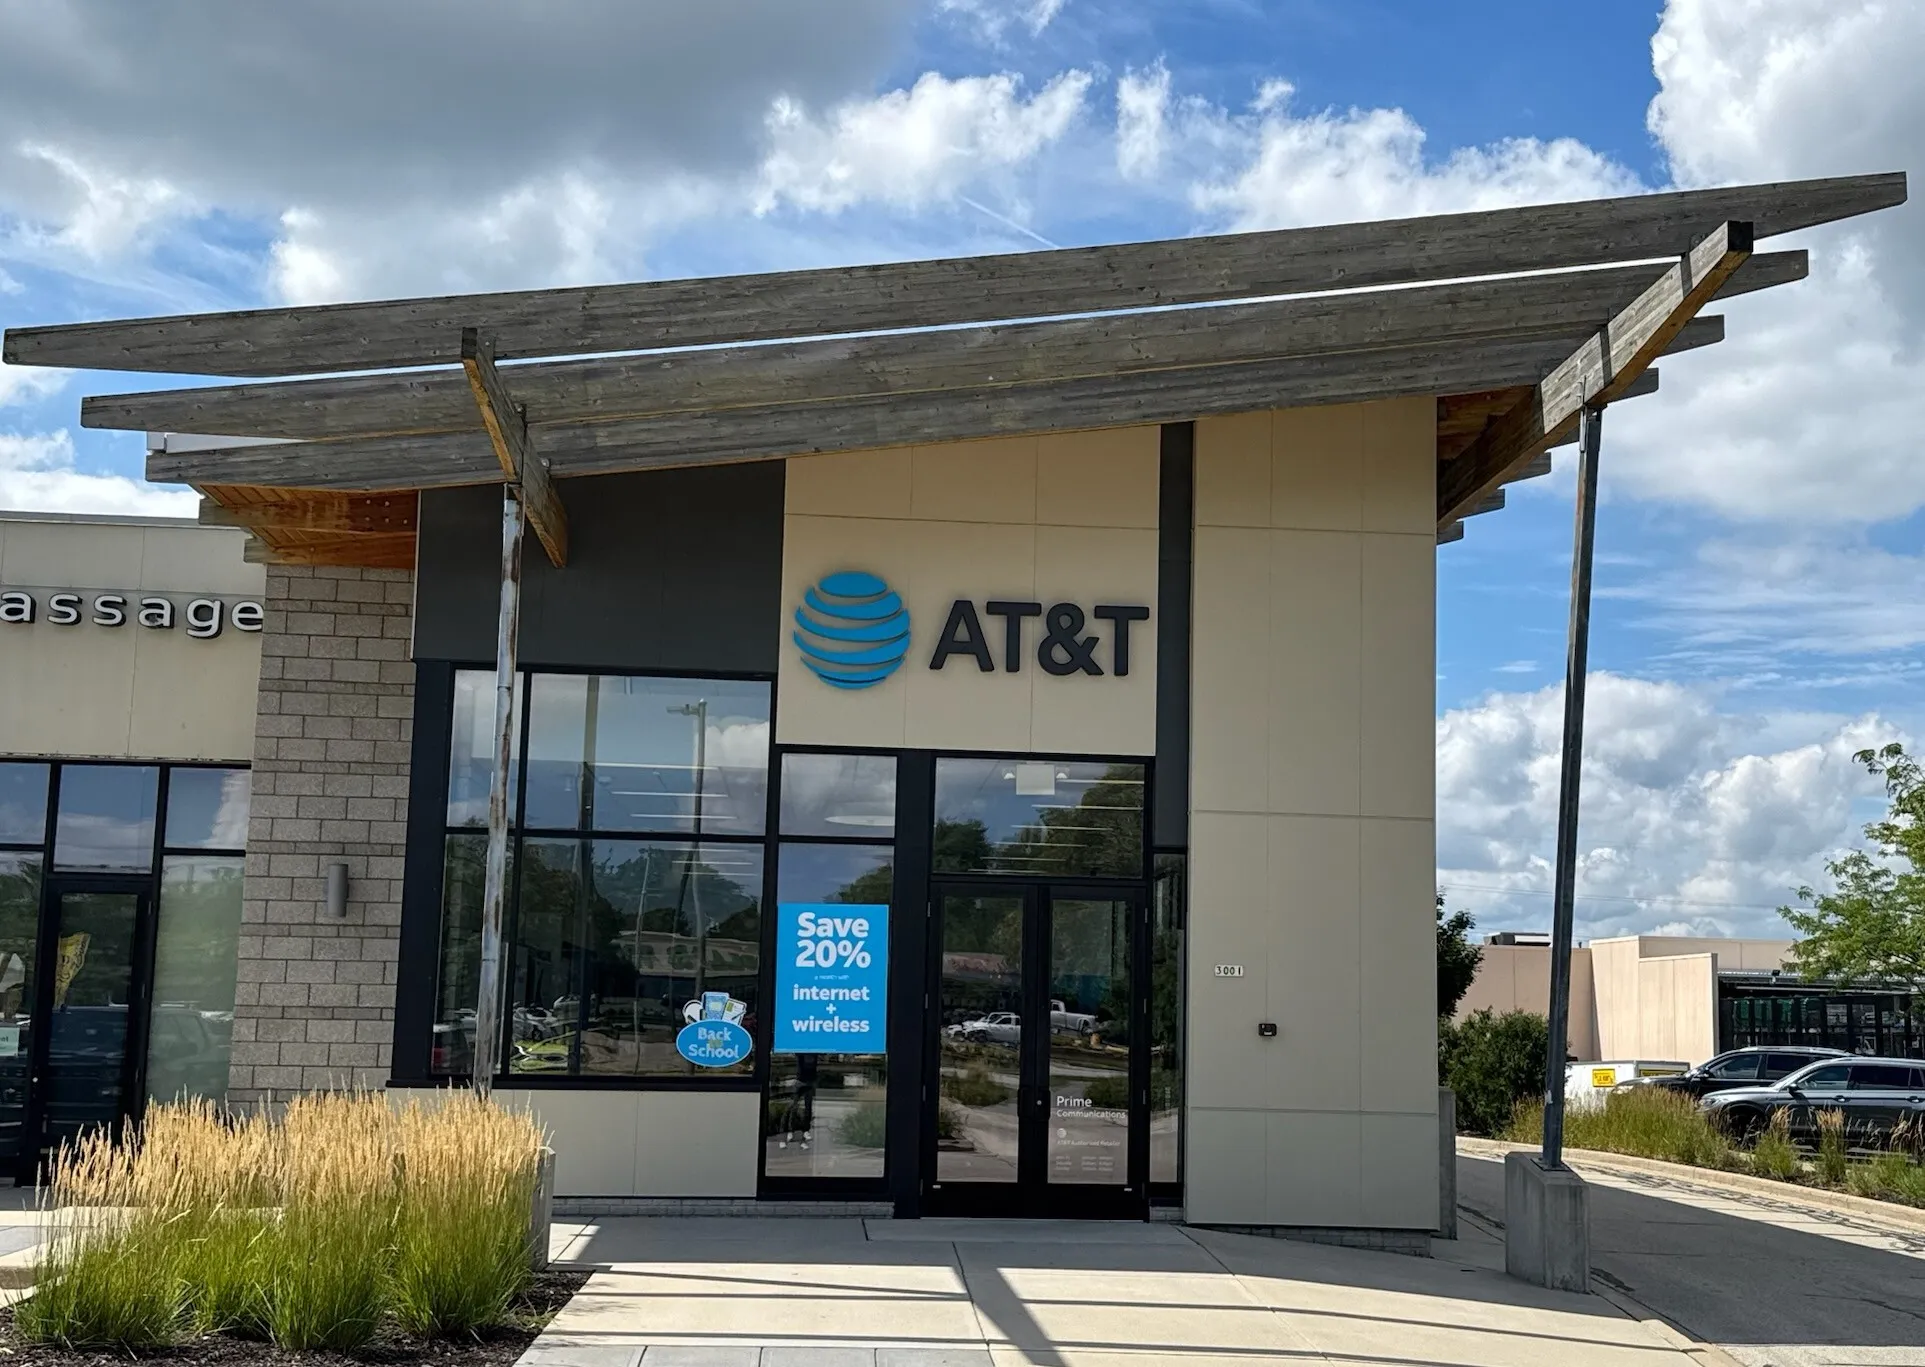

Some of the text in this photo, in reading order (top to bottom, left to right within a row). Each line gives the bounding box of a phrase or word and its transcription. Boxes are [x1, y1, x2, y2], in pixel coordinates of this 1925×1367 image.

[0, 591, 264, 638] assage
[929, 599, 1150, 677] AT&T
[797, 911, 870, 938] Save
[795, 939, 872, 969] 20%
[1216, 965, 1241, 976] 3001
[793, 983, 870, 1001] internet
[792, 1015, 870, 1033] wireless
[697, 1026, 733, 1041] Back
[688, 1043, 740, 1059] School
[1056, 1095, 1092, 1107] Prime
[1056, 1109, 1126, 1118] Communications
